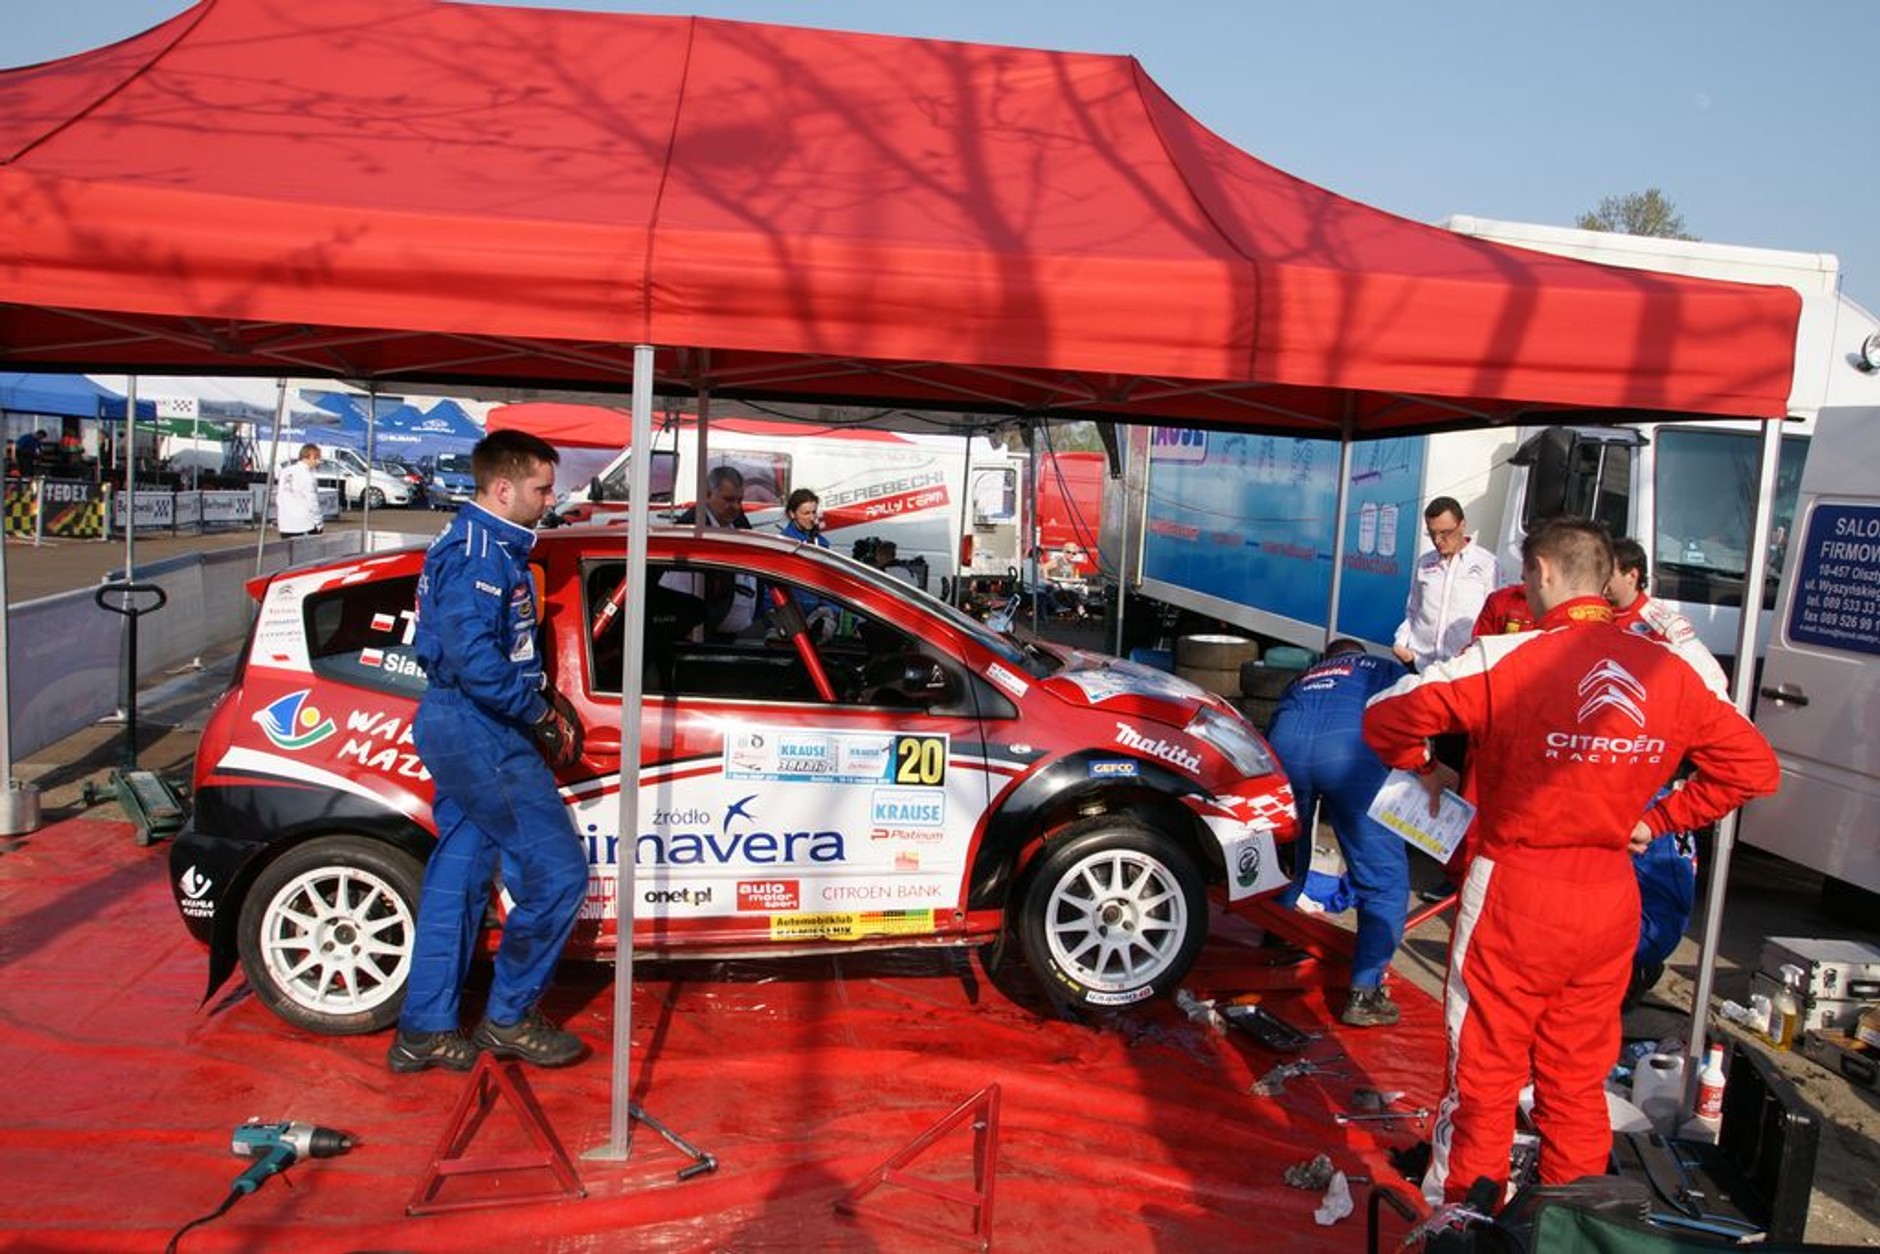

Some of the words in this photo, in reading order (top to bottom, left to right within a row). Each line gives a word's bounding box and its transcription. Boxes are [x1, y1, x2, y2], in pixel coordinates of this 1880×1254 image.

[1834, 517, 1880, 538] SALO
[781, 744, 825, 756] KRAUSE
[898, 737, 943, 784] 20
[653, 808, 710, 826] źródło
[876, 803, 940, 821] KRAUSE
[644, 887, 712, 906] onet.pl
[739, 883, 785, 894] auto
[749, 892, 793, 901] motor
[898, 884, 941, 898] BANK
[776, 915, 853, 927] Automobilklub
